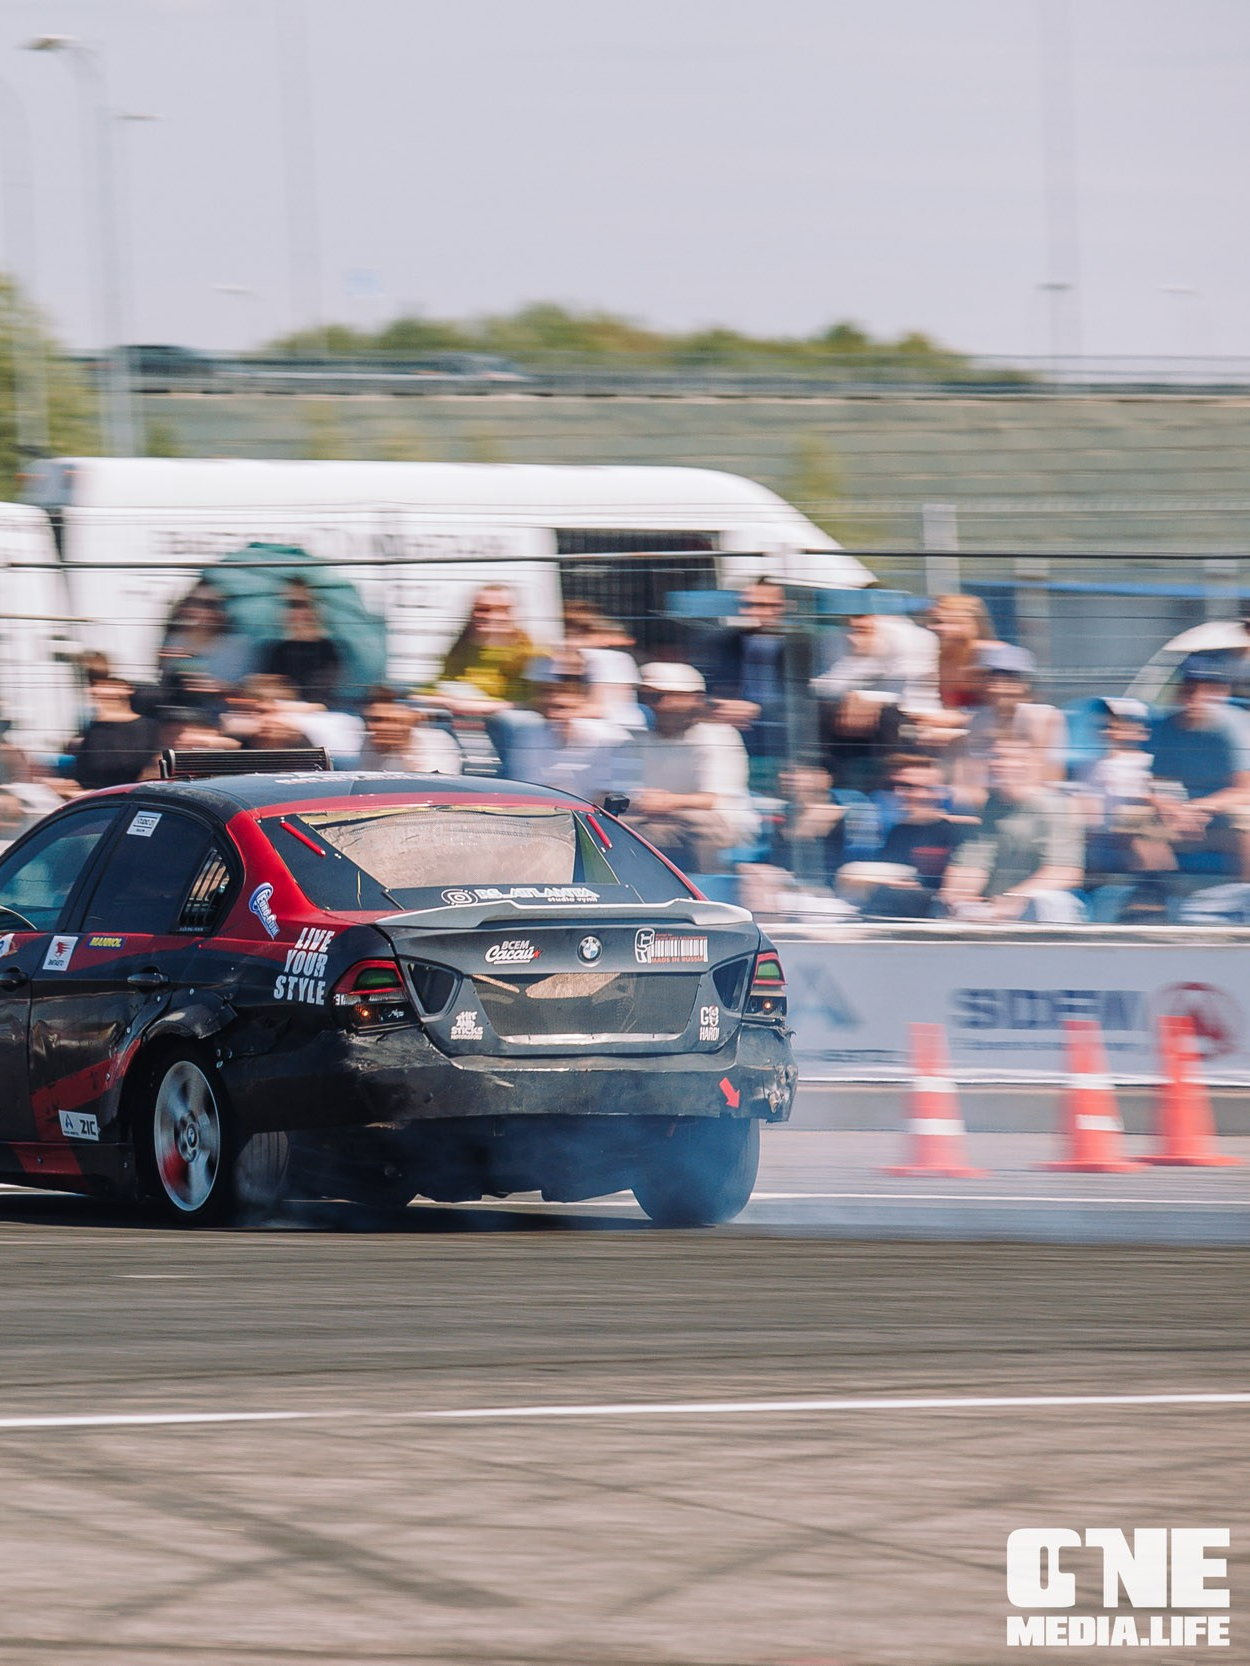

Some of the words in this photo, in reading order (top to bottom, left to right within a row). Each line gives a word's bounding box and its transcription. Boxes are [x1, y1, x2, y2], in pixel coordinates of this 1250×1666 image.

[89, 937, 122, 947] MANNOL
[294, 927, 336, 953] LIVE
[283, 949, 328, 977] YOUR
[273, 974, 326, 1006] STYLE
[79, 1119, 97, 1136] ZIC
